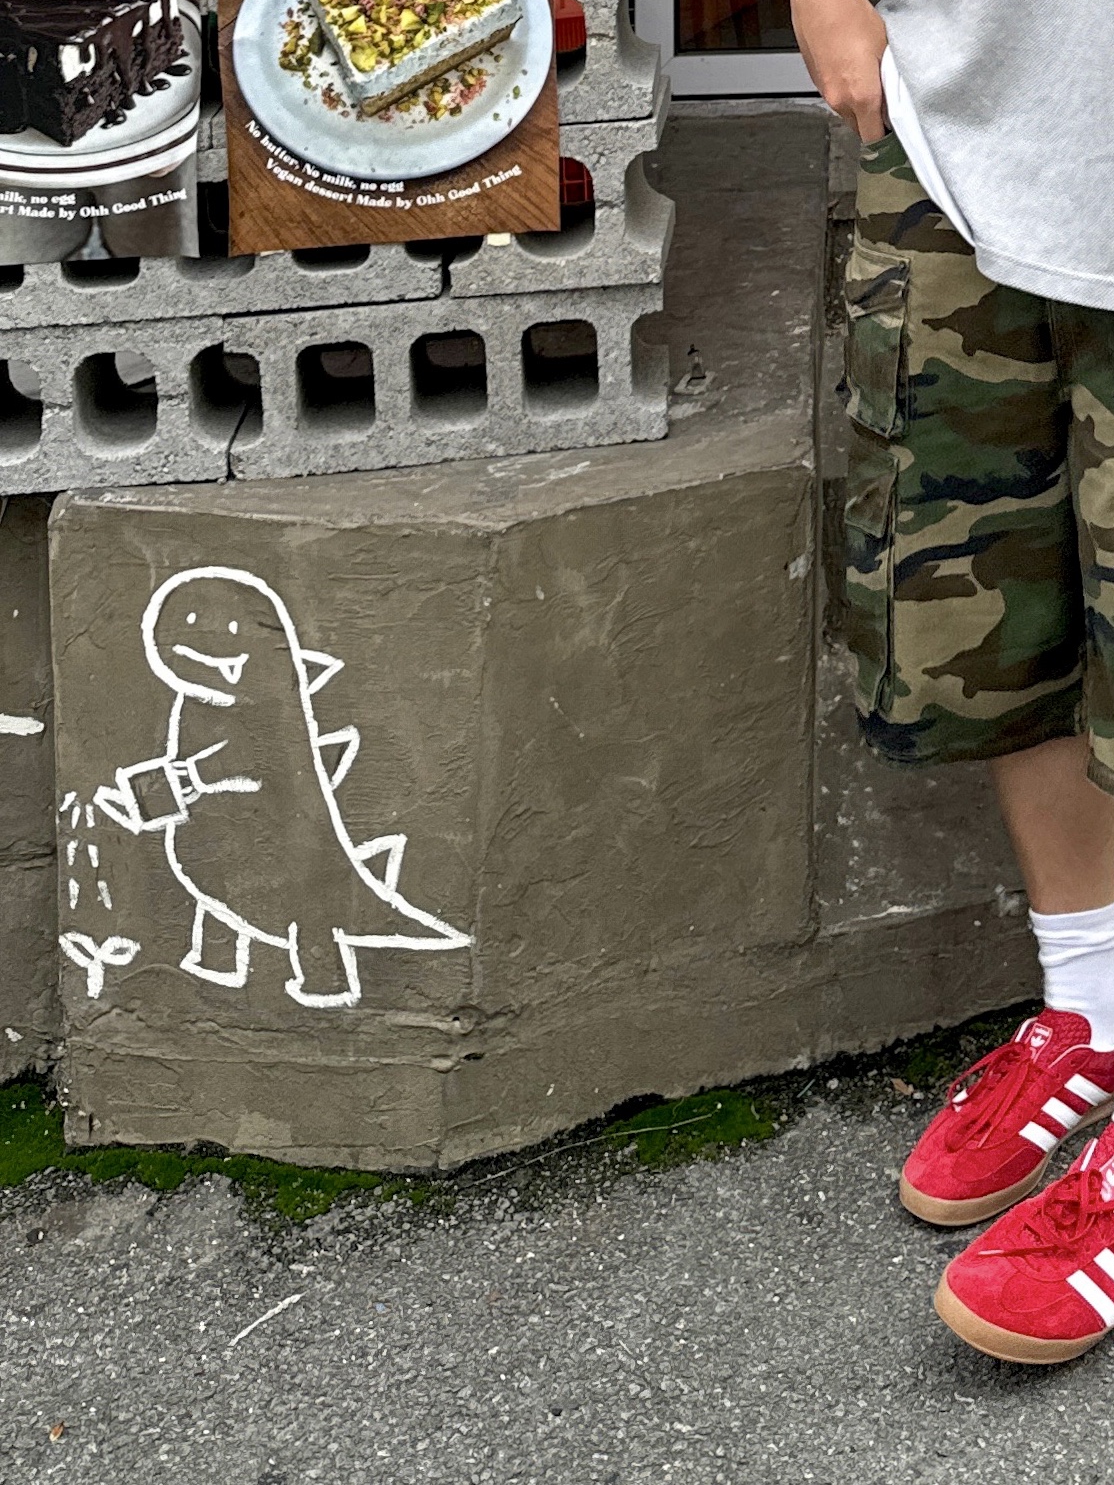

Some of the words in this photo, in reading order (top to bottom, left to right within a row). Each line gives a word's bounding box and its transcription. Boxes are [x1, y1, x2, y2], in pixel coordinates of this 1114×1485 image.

[246, 119, 261, 138] No
[301, 164, 320, 179] No
[322, 172, 357, 190] milk,
[360, 181, 377, 192] no
[379, 180, 405, 194] egg
[18, 206, 55, 218] Made
[58, 208, 77, 221] by
[79, 206, 109, 218] Ohh
[112, 198, 147, 214] Good
[148, 188, 188, 207] Thing
[30, 195, 48, 204] no
[51, 193, 77, 206] egg
[265, 157, 303, 187] Vegan
[304, 180, 353, 204] dessert
[356, 192, 392, 208] Made
[396, 196, 413, 210] by
[416, 192, 445, 206] Ohh
[448, 182, 480, 201] Good
[482, 164, 523, 190] Thing
